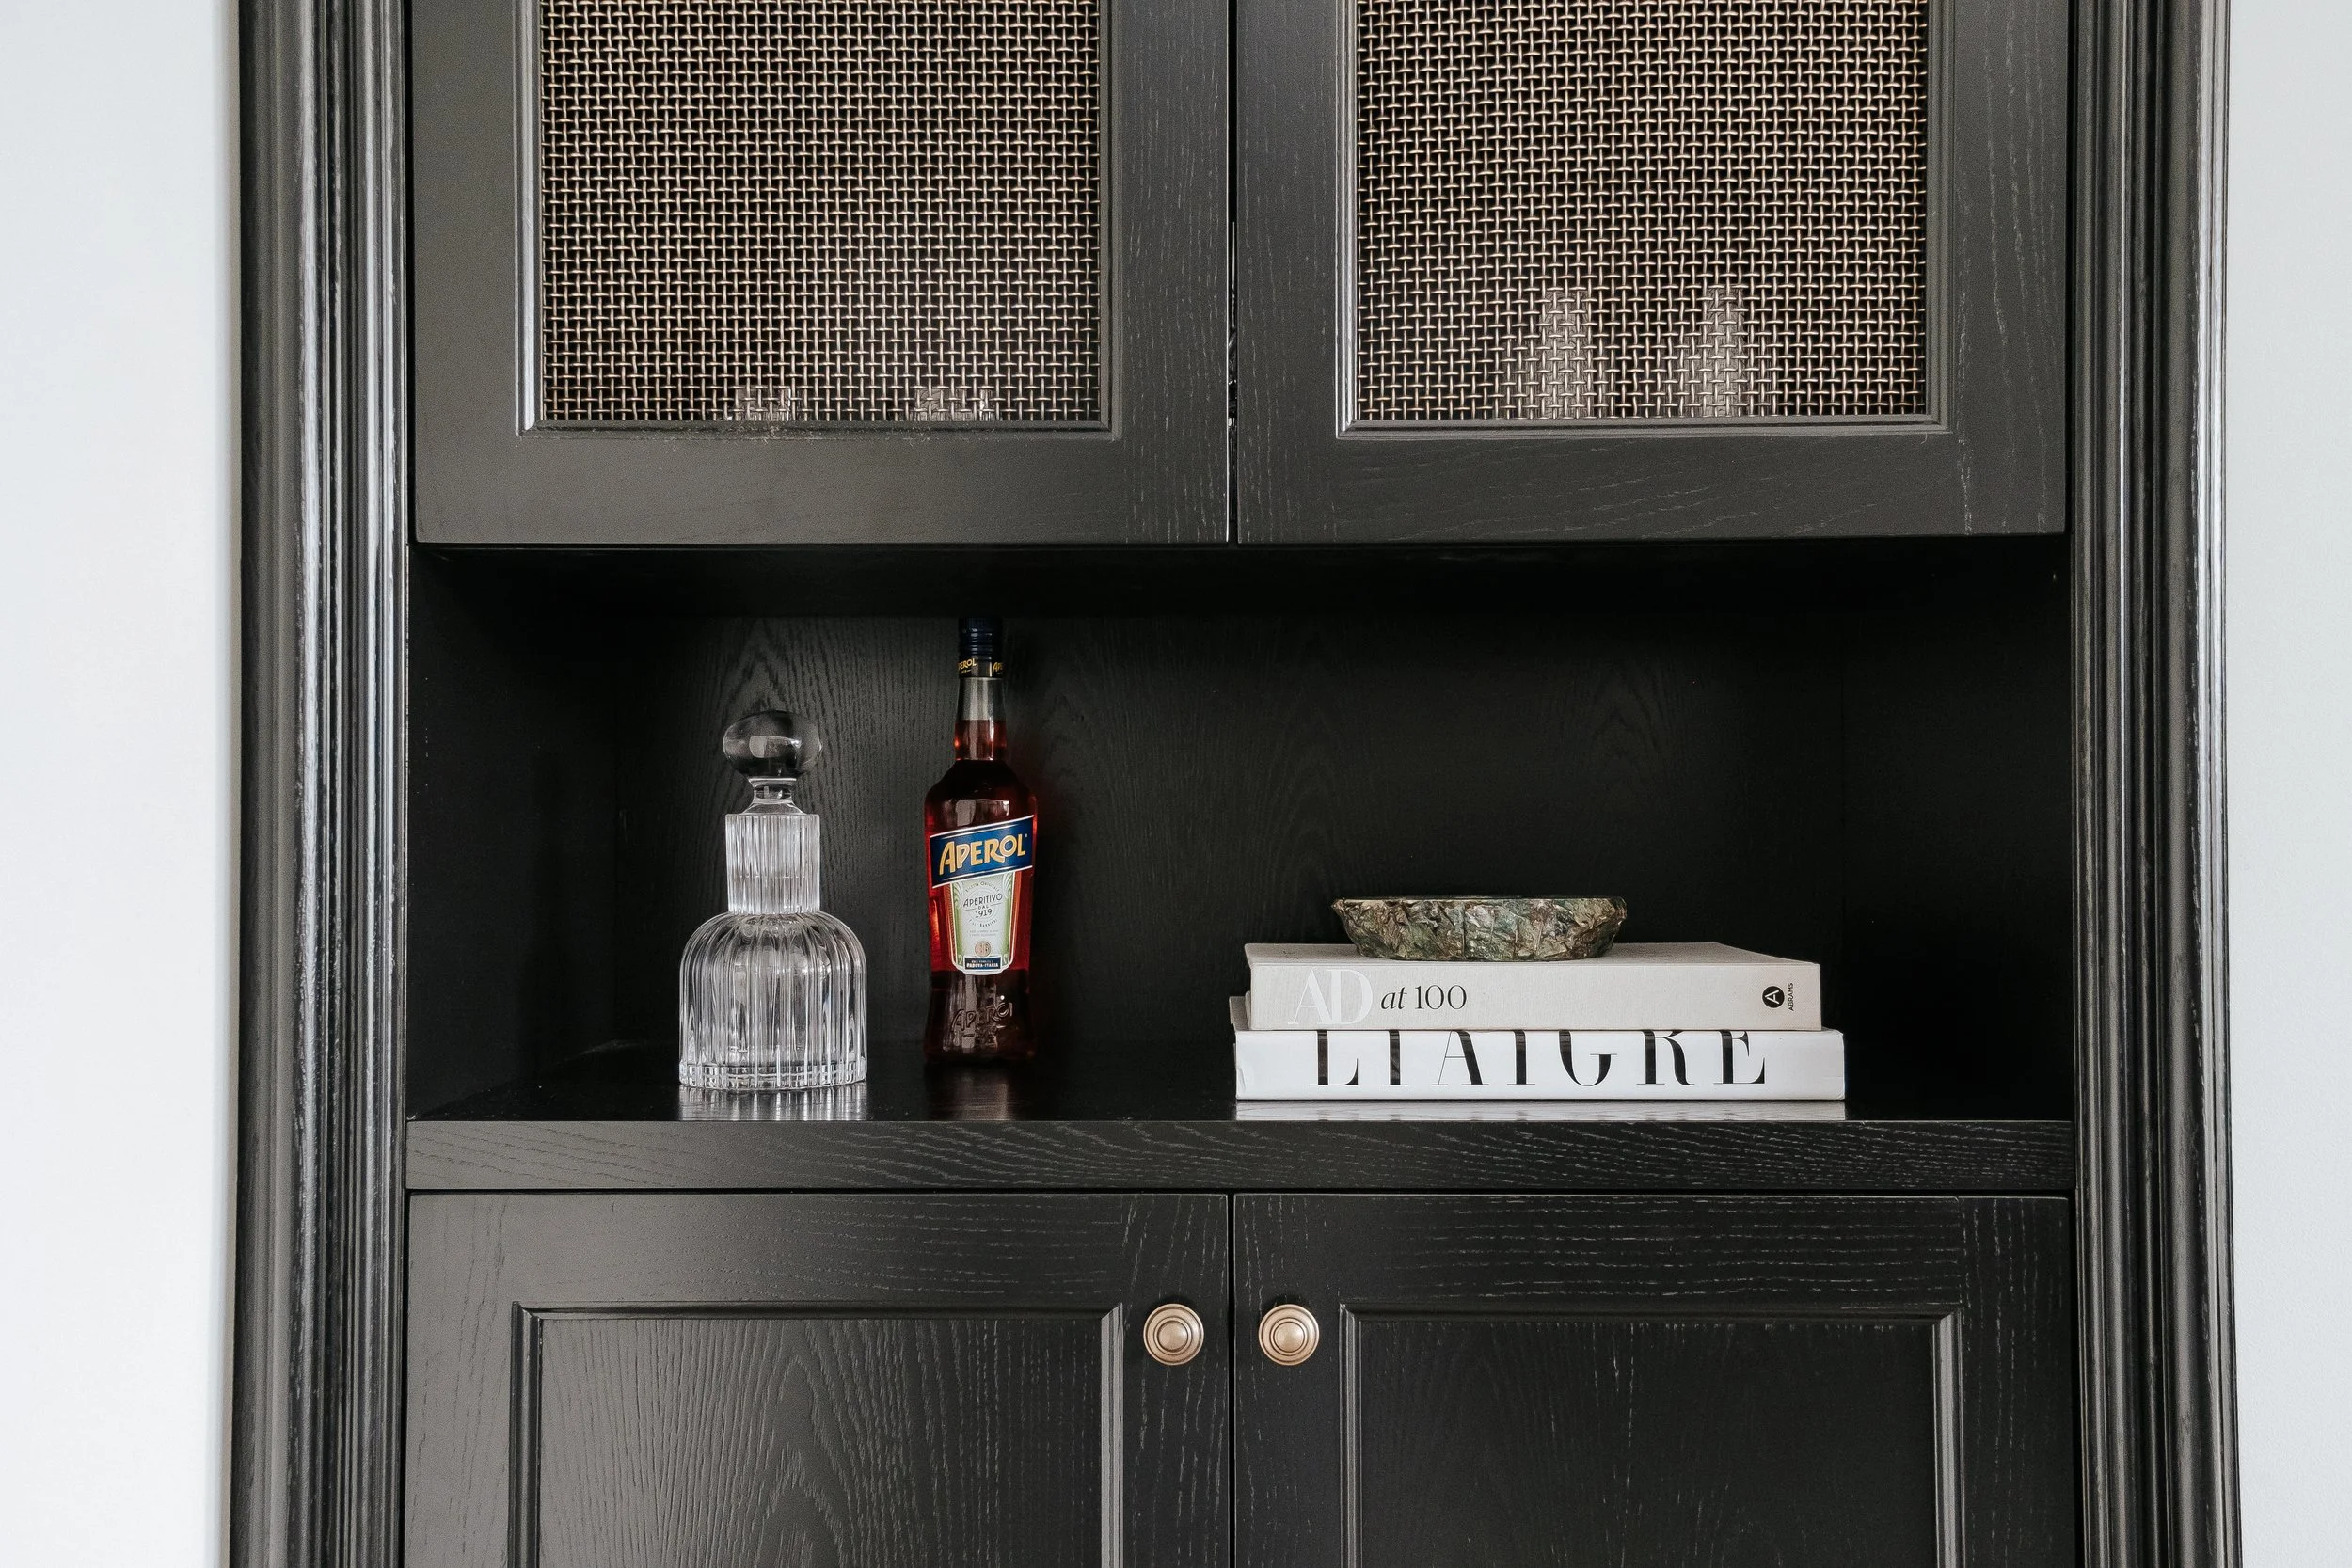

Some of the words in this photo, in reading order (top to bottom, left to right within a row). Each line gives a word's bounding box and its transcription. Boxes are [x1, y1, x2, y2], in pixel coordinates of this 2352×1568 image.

[939, 833, 1026, 876] APEROL
[963, 893, 1003, 908] APERITIVO
[975, 908, 993, 918] 1919
[1288, 968, 1374, 1025] AD
[1380, 987, 1407, 1010] at
[1415, 985, 1467, 1010] 100
[1310, 1029, 1765, 1087] LIAIGRE
